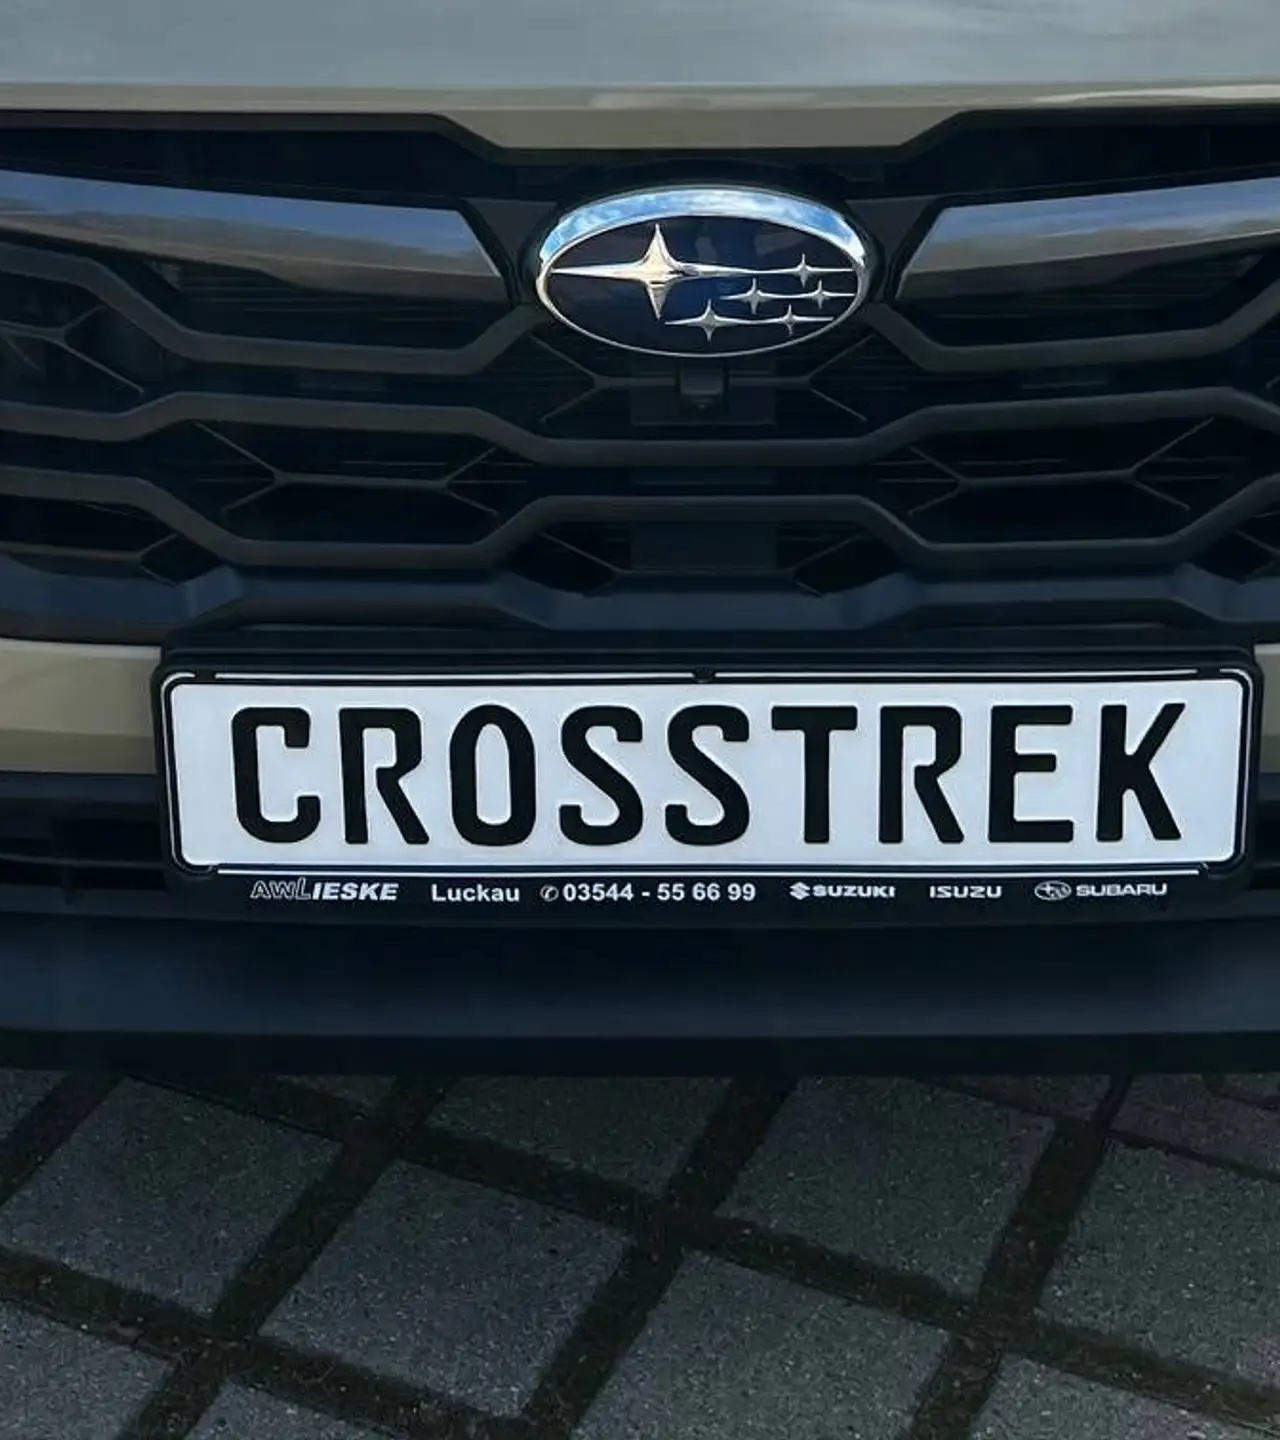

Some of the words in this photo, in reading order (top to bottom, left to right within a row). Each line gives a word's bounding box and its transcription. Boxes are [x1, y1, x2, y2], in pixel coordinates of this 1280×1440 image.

[230, 702, 1187, 846] CROSSTREK
[431, 883, 520, 903] Luckau
[562, 883, 634, 902] 03544
[657, 883, 686, 901] 55
[691, 883, 721, 901] 66
[727, 883, 756, 901] 99
[812, 885, 896, 898] SUZUKI
[929, 885, 1002, 899] ISUZU
[1076, 883, 1168, 897] SUBARU
